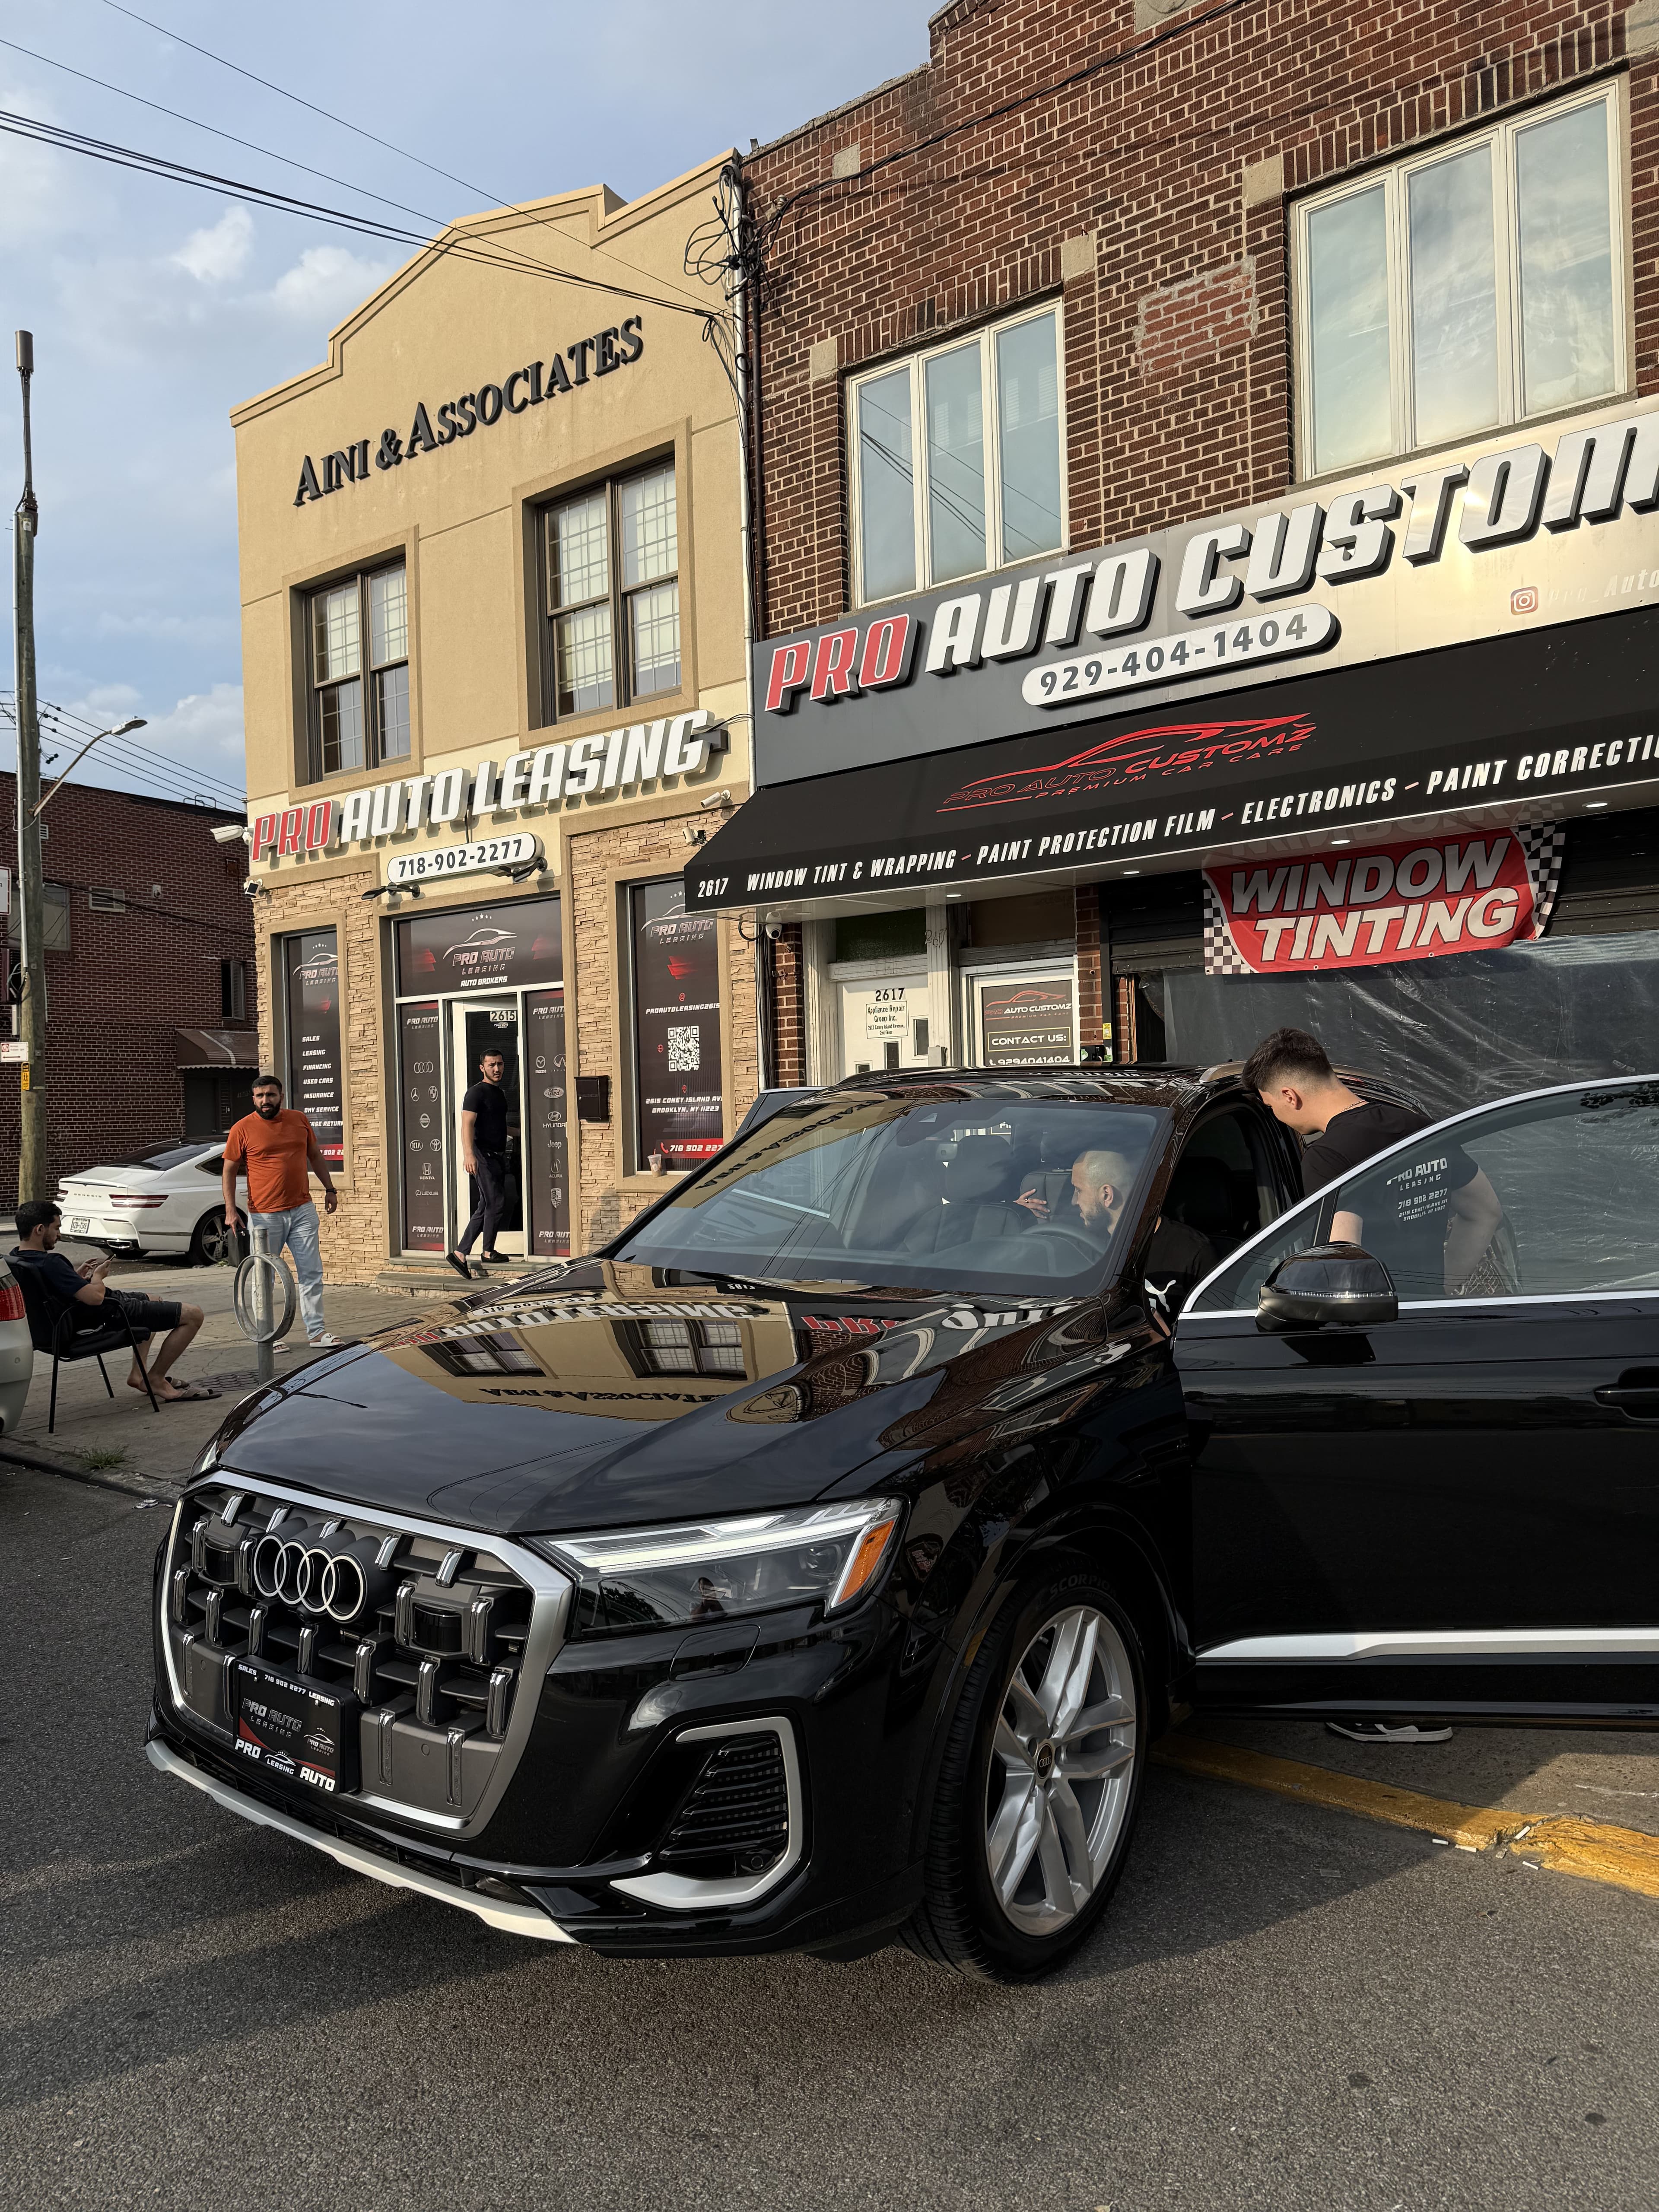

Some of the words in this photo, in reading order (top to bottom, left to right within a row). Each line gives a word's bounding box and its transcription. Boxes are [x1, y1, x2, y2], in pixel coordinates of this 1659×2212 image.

[292, 439, 371, 506] AINI
[375, 428, 403, 470] &
[404, 315, 643, 460] ASSOCIATES
[765, 613, 918, 714] PRO
[925, 549, 1158, 675] AUTO
[1039, 614, 1310, 697] 929-404-1404
[943, 783, 1015, 804] PRO
[1017, 768, 1116, 793] AUTO
[1125, 724, 1317, 774] CUSTOMZ
[1035, 773, 1147, 799] PREMIUM
[1161, 761, 1214, 776] CAR
[1229, 743, 1303, 763] CARE
[252, 799, 340, 862] PRO
[341, 767, 470, 843] AUTO
[472, 709, 714, 815] LEASING
[698, 877, 728, 899] 2617
[747, 867, 808, 892] WINDOW
[813, 863, 849, 885] TINT
[852, 861, 863, 880] &
[870, 849, 957, 878] WRAPPING
[976, 839, 1032, 864] PAINT
[1038, 819, 1158, 857] PROTECTION
[1164, 808, 1216, 838] FILM
[1241, 777, 1395, 825] ELECTRONICS
[1426, 759, 1507, 795] PAINT
[398, 839, 522, 878] 718-902-2277
[1231, 836, 1512, 914] WINDOW
[650, 924, 677, 937] PRO
[679, 919, 714, 933] AUTO
[1255, 887, 1520, 963] TINTING
[660, 933, 704, 944] LEASING
[452, 951, 478, 966] PRO
[480, 947, 515, 963] AUTO
[299, 969, 318, 980] PRO
[462, 964, 505, 975] LEASING
[478, 976, 508, 985] BROKERS
[876, 988, 905, 1001] 2617
[491, 1011, 515, 1020] 2615
[645, 1002, 720, 1014] PROAUTOLEASING2615
[868, 1006, 888, 1014] Appliance
[889, 1004, 905, 1013] Repair
[1004, 1006, 1028, 1014] AUTO
[1029, 1003, 1072, 1012] CUSTOMZ
[992, 1035, 1045, 1045] CONTACT
[547, 1140, 562, 1149] Jeep
[1415, 1157, 1447, 1177] AUTO
[1400, 1174, 1441, 1191] LEASING
[1398, 1199, 1411, 1209] 718
[1414, 1194, 1427, 1205] 902
[1429, 1188, 1447, 1200] 2277
[238, 1664, 257, 1675] SALES
[264, 1675, 274, 1683] 718
[276, 1678, 288, 1688] 902
[289, 1683, 306, 1694] 2277
[308, 1691, 335, 1706] LEASING
[242, 1698, 267, 1717] PRO
[268, 1709, 302, 1732] AUTO
[250, 1716, 292, 1738] LEASING
[307, 1738, 319, 1747] PRO
[319, 1743, 334, 1753] AUTO
[235, 1738, 261, 1759] PRO
[299, 1767, 336, 1792] AUTO
[267, 1758, 294, 1775] LEASING
